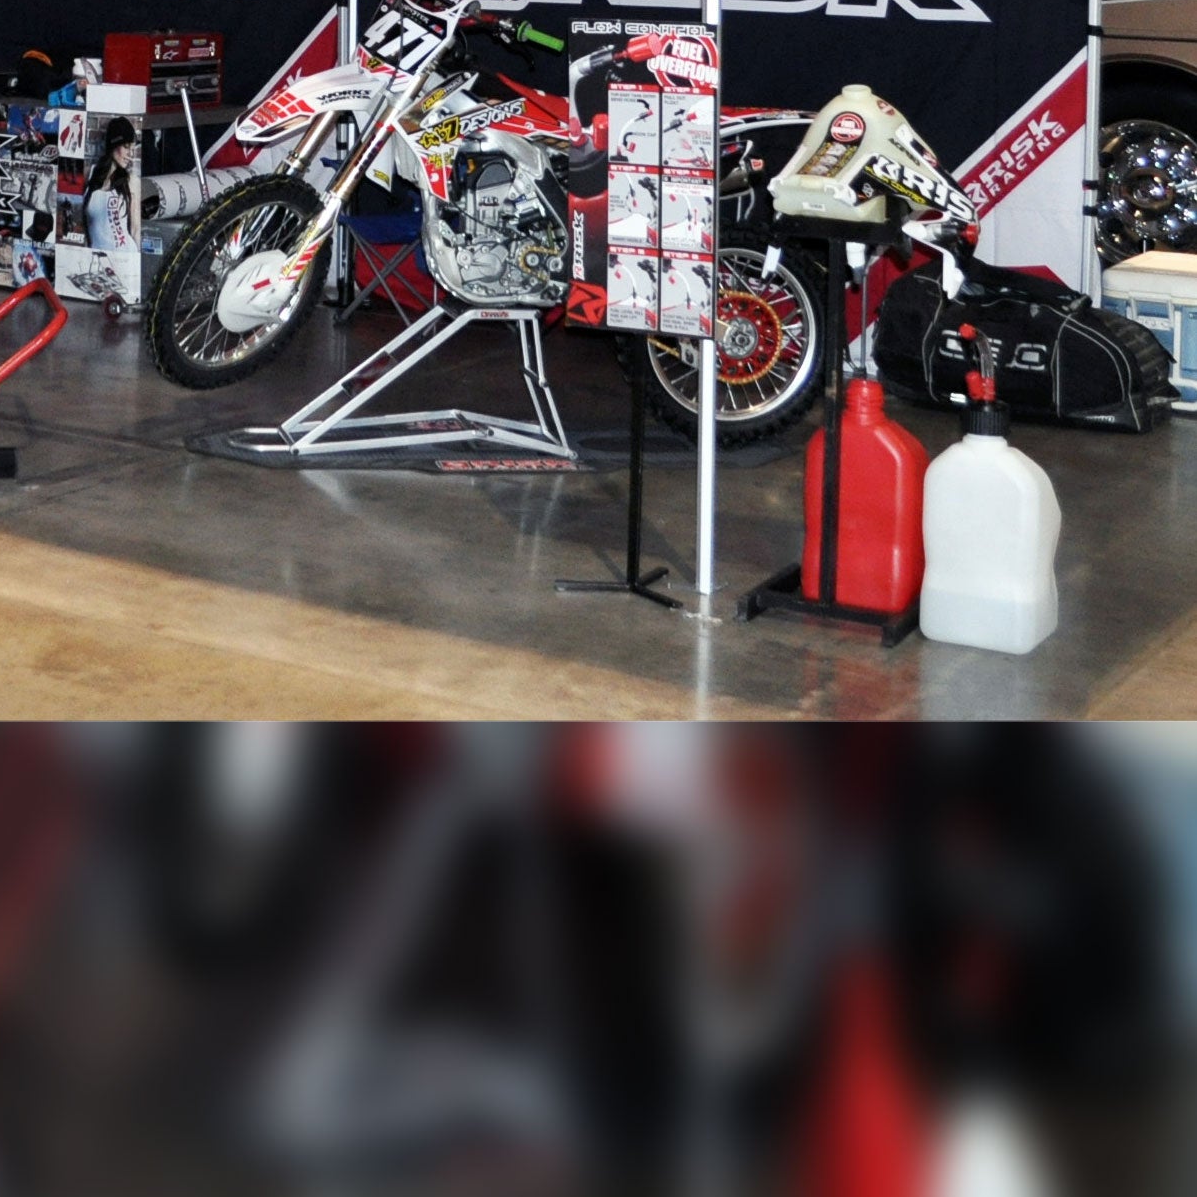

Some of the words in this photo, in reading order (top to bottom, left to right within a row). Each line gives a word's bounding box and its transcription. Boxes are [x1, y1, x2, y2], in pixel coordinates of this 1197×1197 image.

[571, 21, 621, 34] FLOW
[625, 23, 715, 37] CONTROL
[672, 39, 706, 63] FUEL
[647, 54, 719, 86] OVERFLOW
[459, 100, 524, 134] DESIGNS
[979, 109, 1059, 188] RISK
[988, 123, 1066, 197] RACING
[900, 172, 976, 222] RIS
